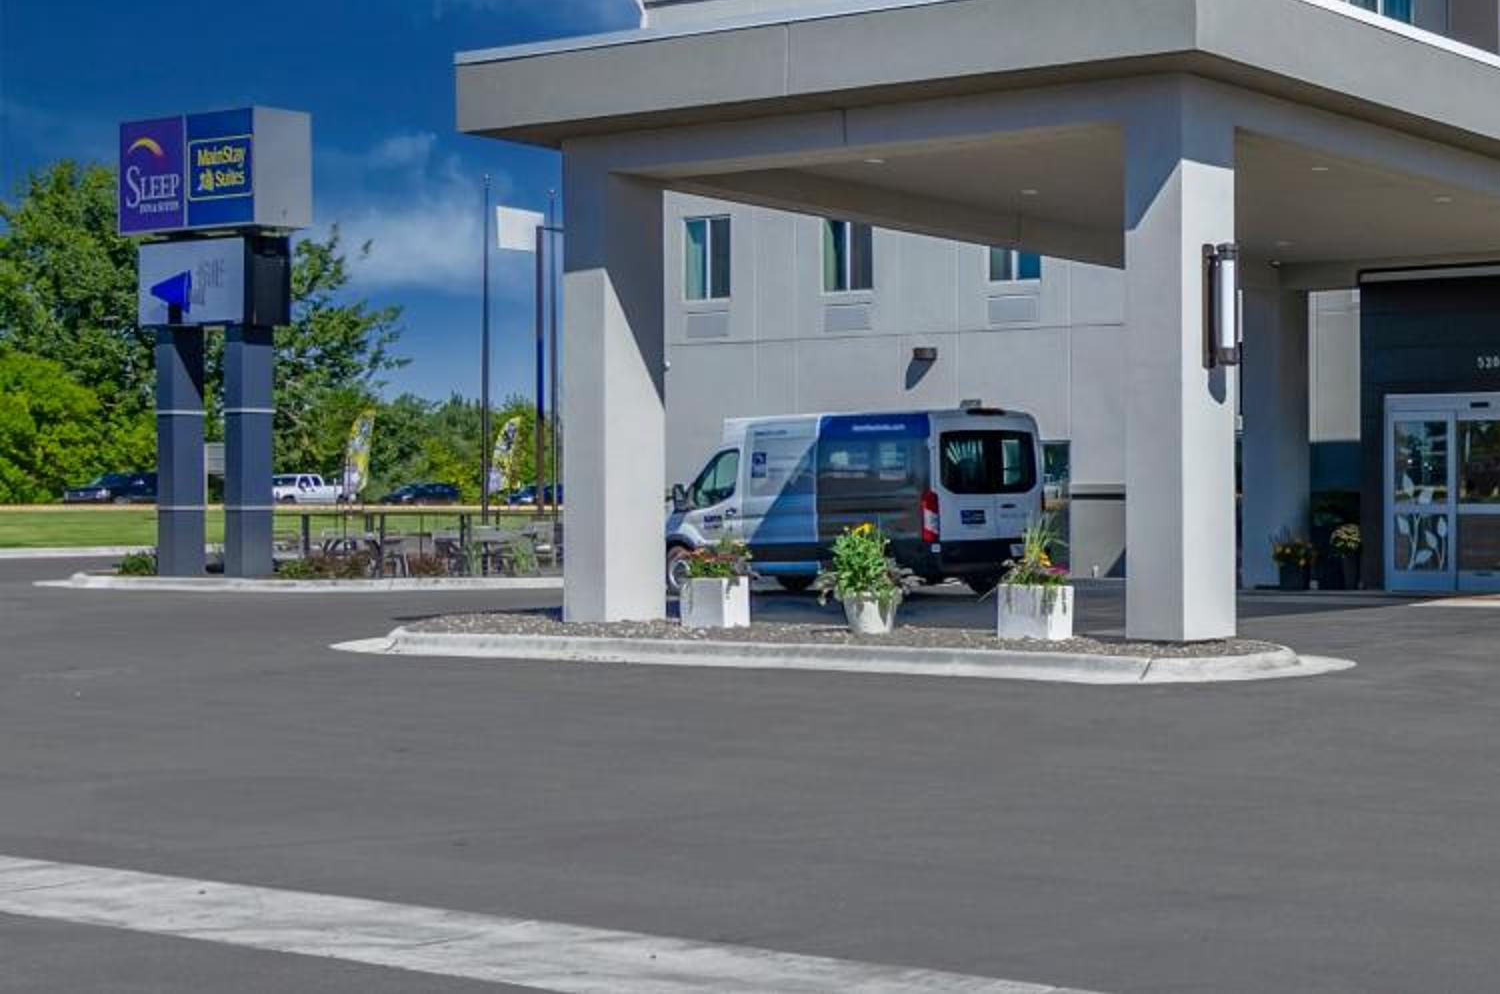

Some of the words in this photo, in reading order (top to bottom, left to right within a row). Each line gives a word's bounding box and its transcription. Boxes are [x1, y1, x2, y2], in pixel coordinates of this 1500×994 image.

[197, 145, 246, 168] MainStay
[125, 165, 180, 208] SLEEP
[215, 169, 246, 187] Suites
